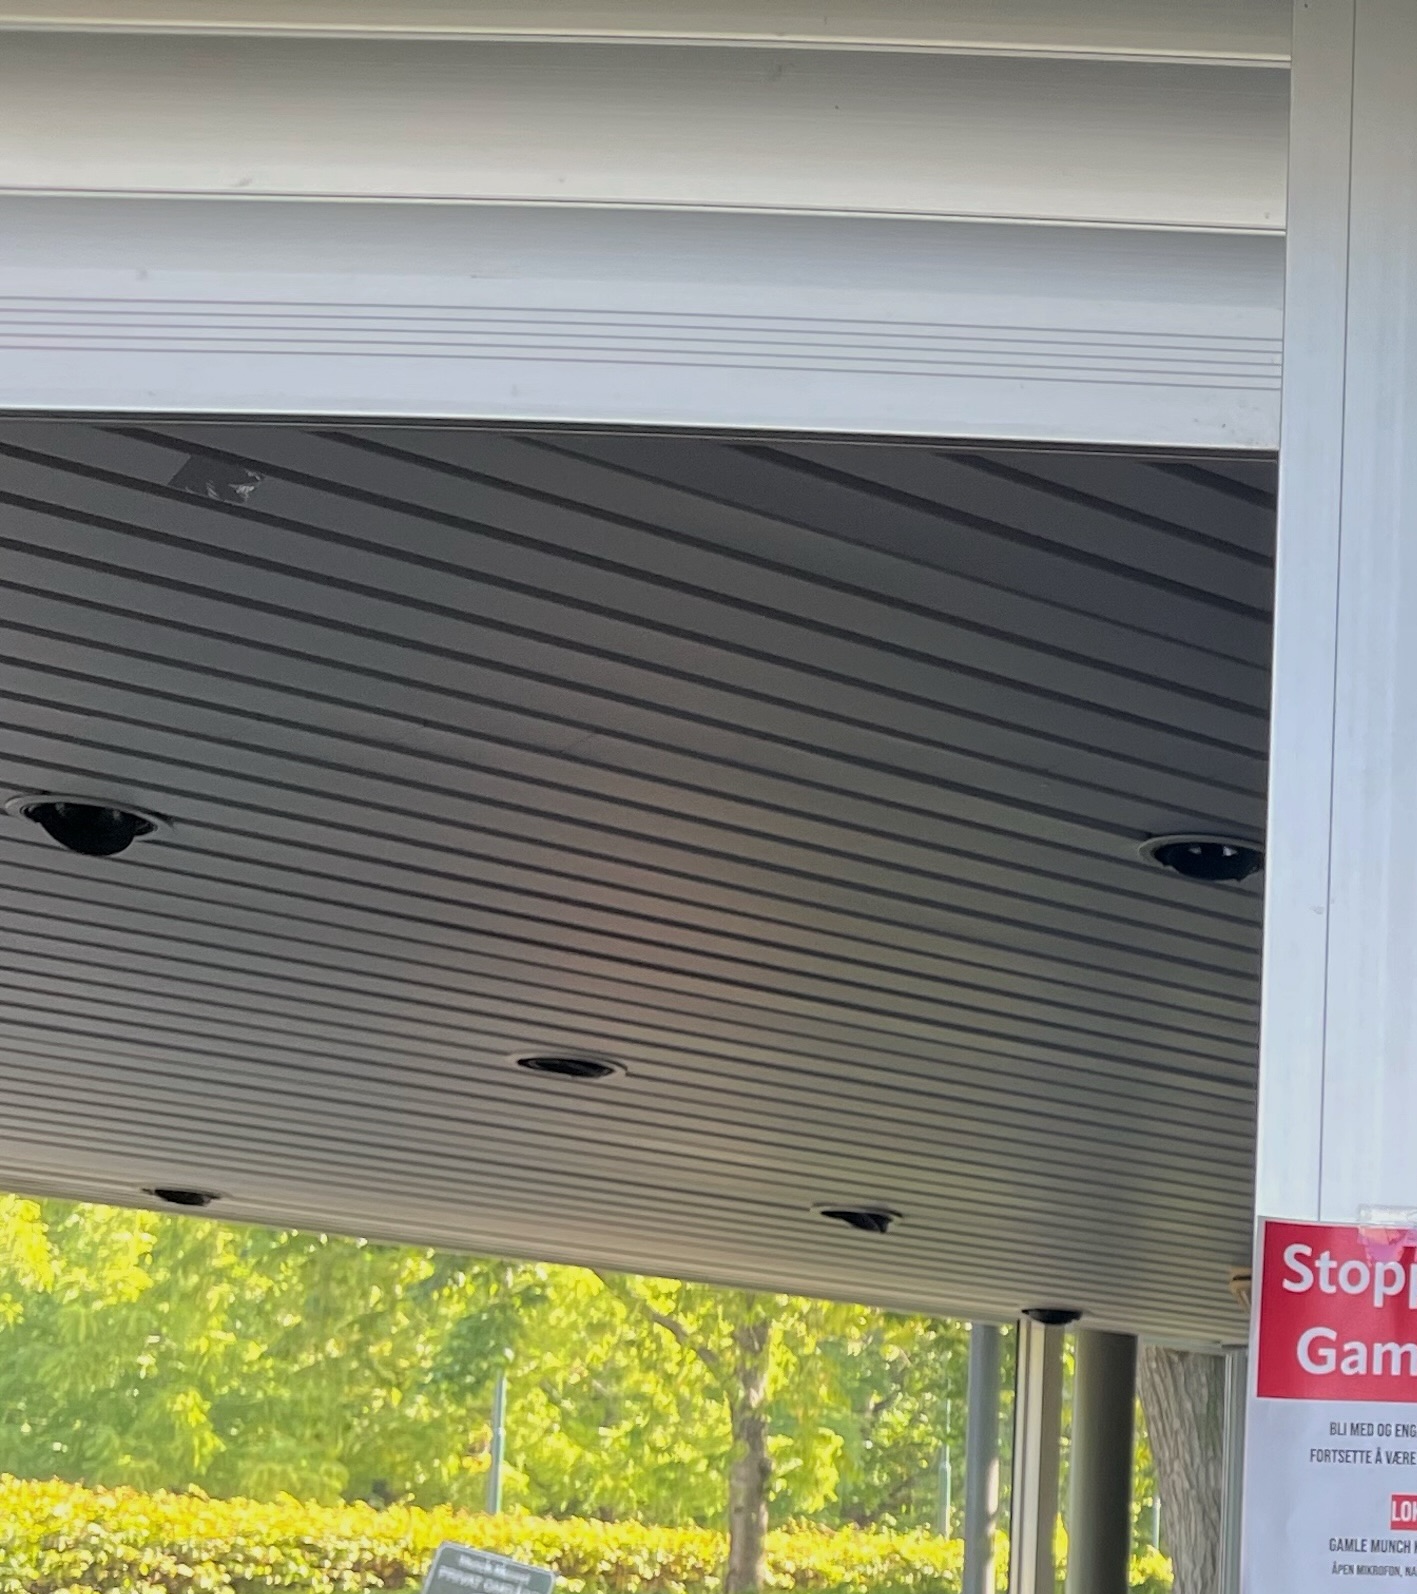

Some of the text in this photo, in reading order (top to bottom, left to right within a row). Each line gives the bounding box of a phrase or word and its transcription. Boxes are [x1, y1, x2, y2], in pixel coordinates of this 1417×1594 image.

[1329, 1421, 1347, 1436] BLI
[1350, 1422, 1374, 1437] MED
[1377, 1423, 1392, 1437] OG
[1309, 1448, 1372, 1464] FORTSETTE
[1375, 1446, 1383, 1464] Å
[1386, 1450, 1416, 1466] VÆRE
[1329, 1537, 1367, 1552] GAMLE
[1370, 1538, 1411, 1553] MUNCH
[1331, 1560, 1354, 1575] ÅPEN
